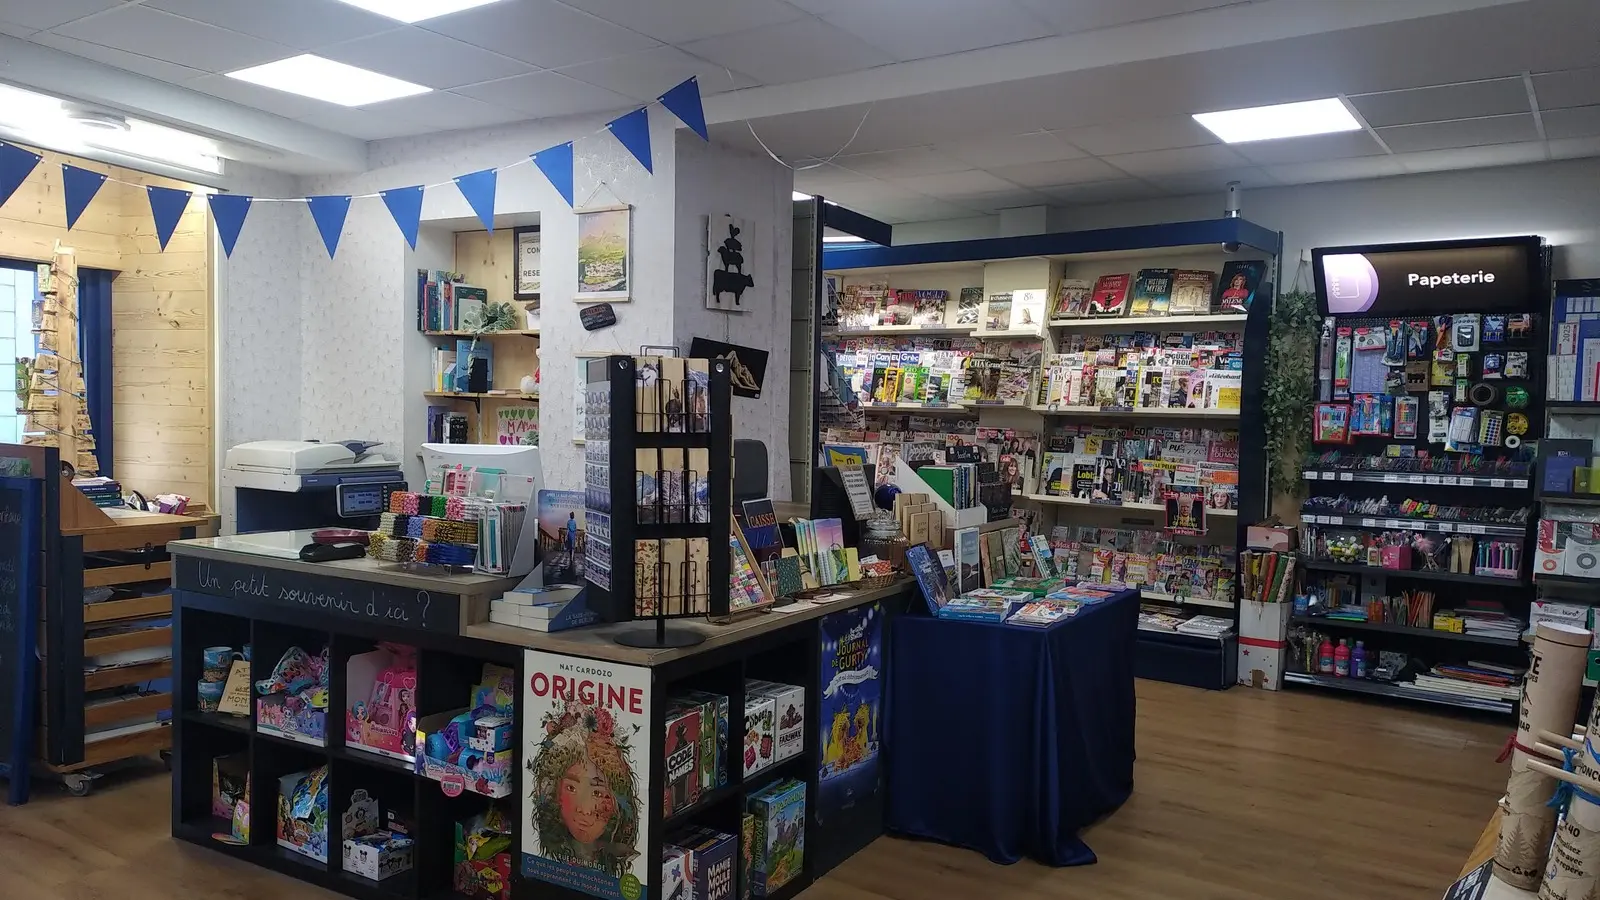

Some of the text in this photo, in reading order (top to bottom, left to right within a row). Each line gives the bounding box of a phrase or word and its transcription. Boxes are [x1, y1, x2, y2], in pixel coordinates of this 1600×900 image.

[1408, 270, 1495, 288] Papeterie
[198, 561, 431, 627] Un petit souvenir d'ici ?
[559, 663, 613, 678] NAT CARDOZO
[530, 672, 643, 714] ORIGINE
[668, 745, 694, 770] CODE
[668, 760, 695, 784] NAMES
[708, 857, 731, 880] MAMIE
[708, 869, 731, 892] MOULE
[708, 881, 730, 900] MAKI
